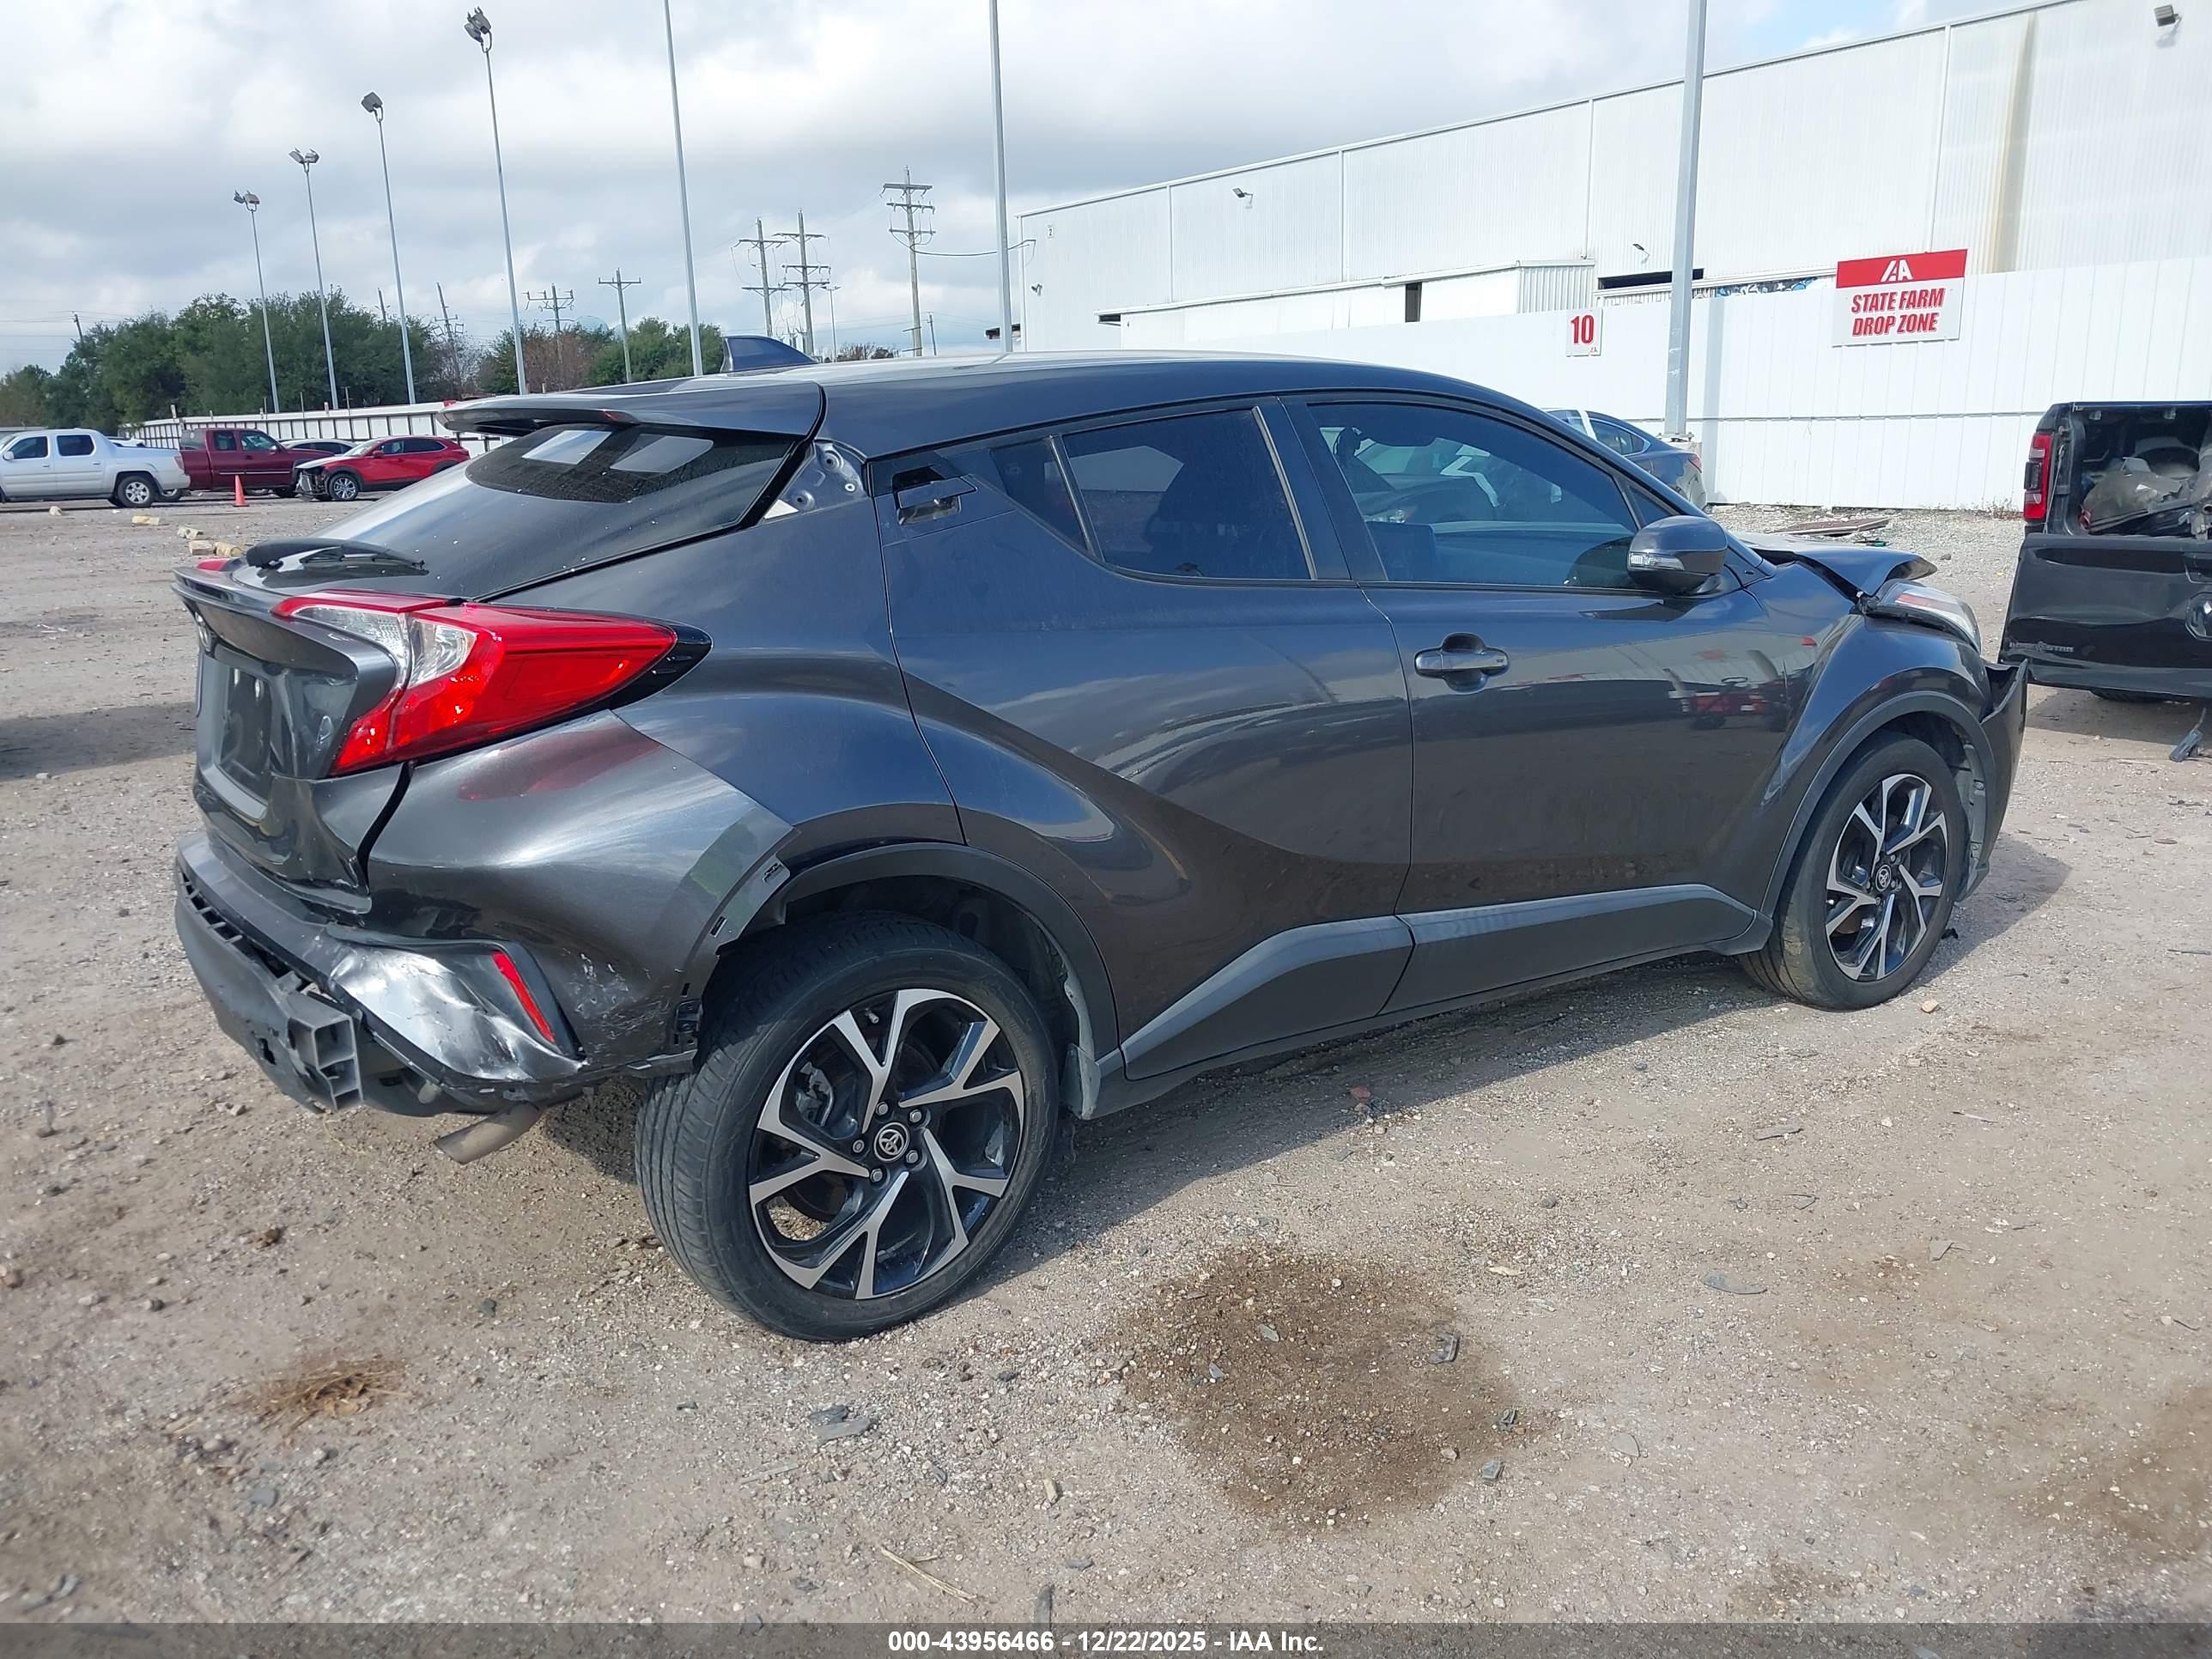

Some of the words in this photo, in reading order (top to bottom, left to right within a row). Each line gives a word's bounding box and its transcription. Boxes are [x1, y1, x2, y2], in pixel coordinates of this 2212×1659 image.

[1851, 291, 1897, 313] STATE
[1899, 288, 1946, 310] FARM
[1570, 314, 1595, 344] 10
[1851, 315, 1896, 337] DROP
[1897, 313, 1940, 333] ZONE
